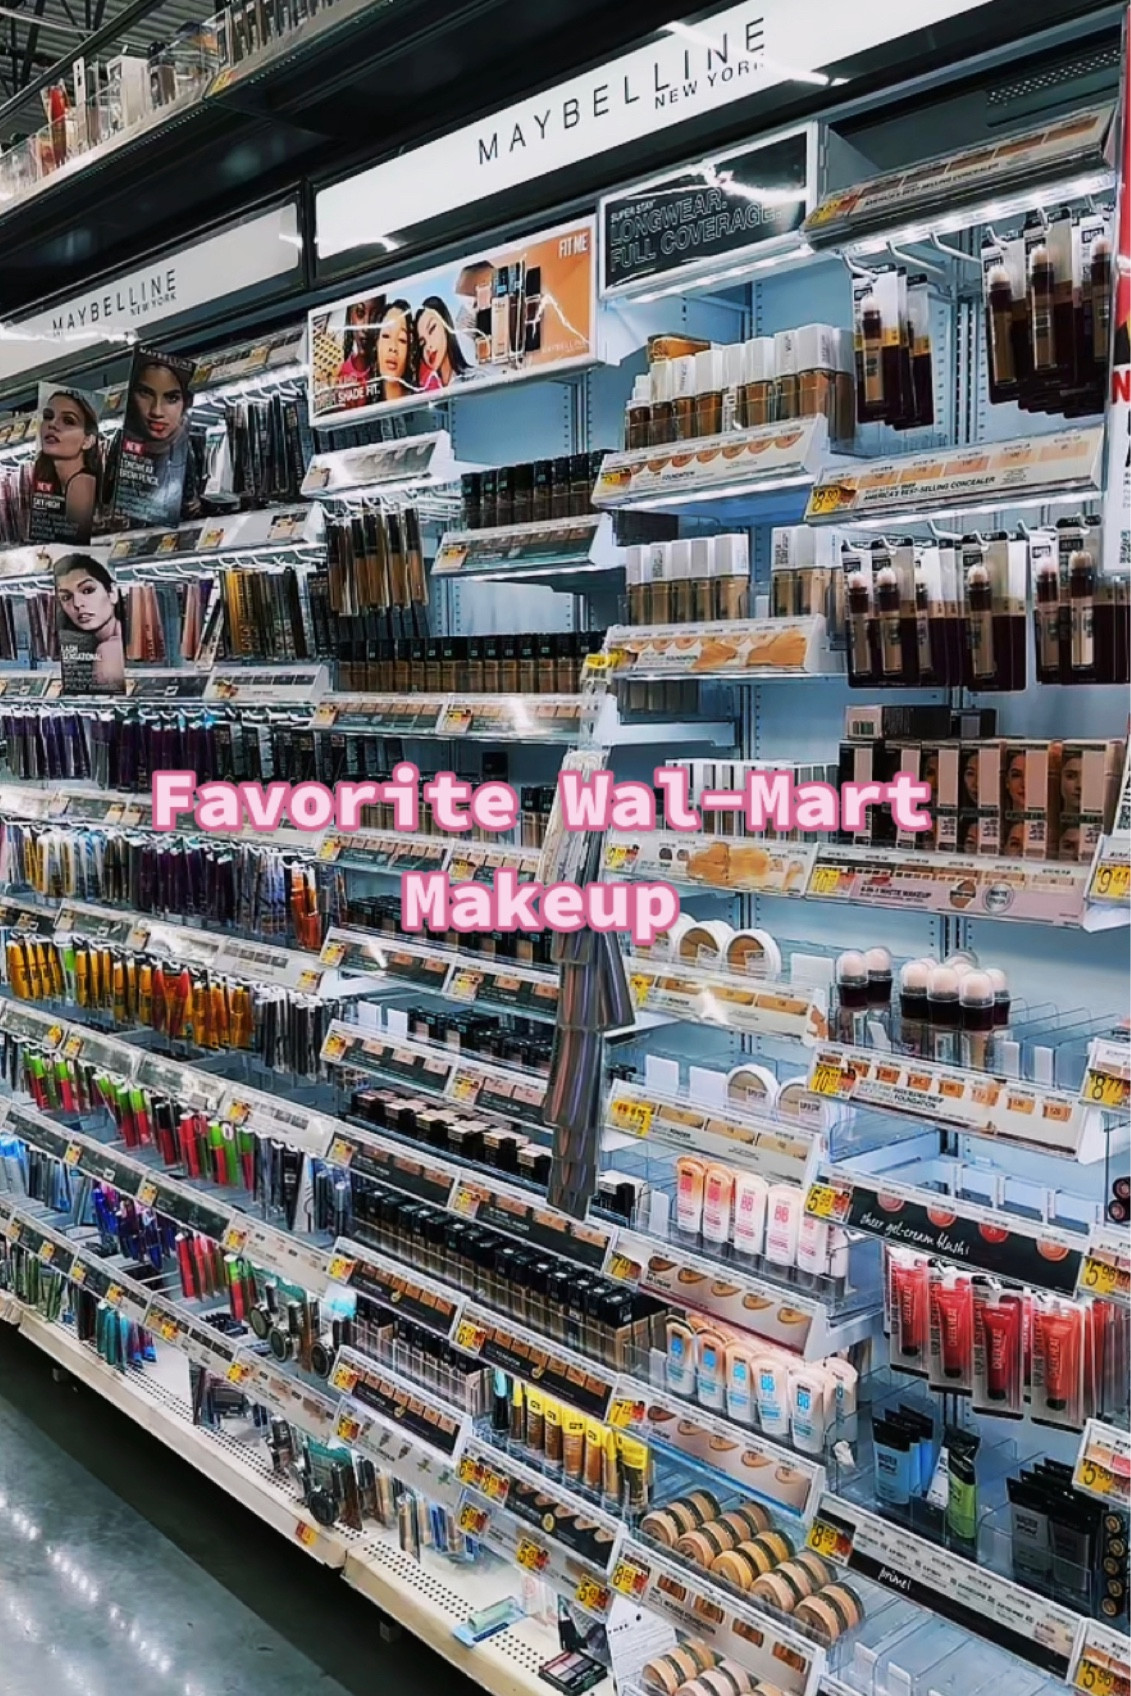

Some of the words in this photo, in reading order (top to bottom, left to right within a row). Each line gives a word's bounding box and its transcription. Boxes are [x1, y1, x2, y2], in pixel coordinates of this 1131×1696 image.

[478, 17, 765, 165] MAYBELLINE
[655, 80, 698, 109] NEW
[559, 236, 574, 259] FIT
[574, 231, 589, 255] ME
[610, 238, 657, 272] FULL
[52, 268, 177, 336] MAYBELLINE
[951, 476, 996, 489] CONCEALER
[859, 1211, 884, 1231] sheer
[885, 1221, 935, 1249] gel-cream
[877, 1565, 912, 1592] prime!
